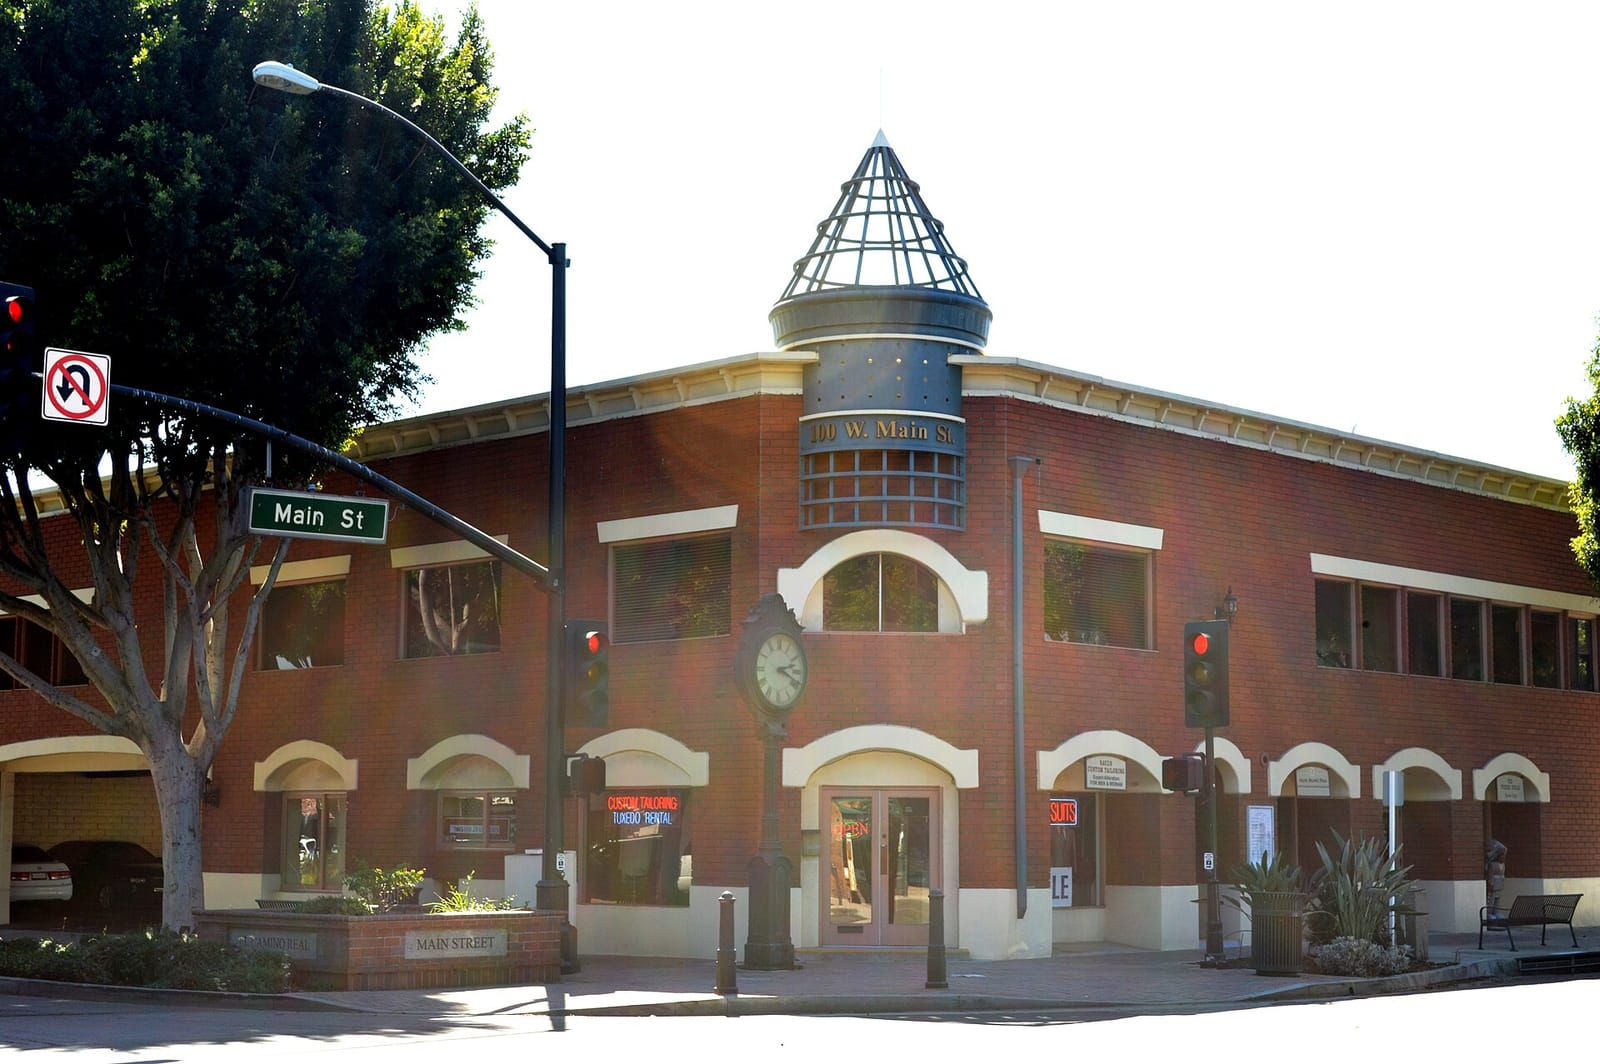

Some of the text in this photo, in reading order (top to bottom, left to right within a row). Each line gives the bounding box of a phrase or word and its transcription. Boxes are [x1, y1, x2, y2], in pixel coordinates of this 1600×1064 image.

[810, 420, 956, 444] 100 W. Main St.
[274, 503, 364, 530] Main St
[607, 795, 679, 810] CUSTOM TAILORING
[613, 811, 673, 825] TUXEDO RENTAL
[1050, 802, 1076, 822] SUITS
[287, 938, 311, 951] REAL
[416, 936, 495, 951] MAIN STREET
